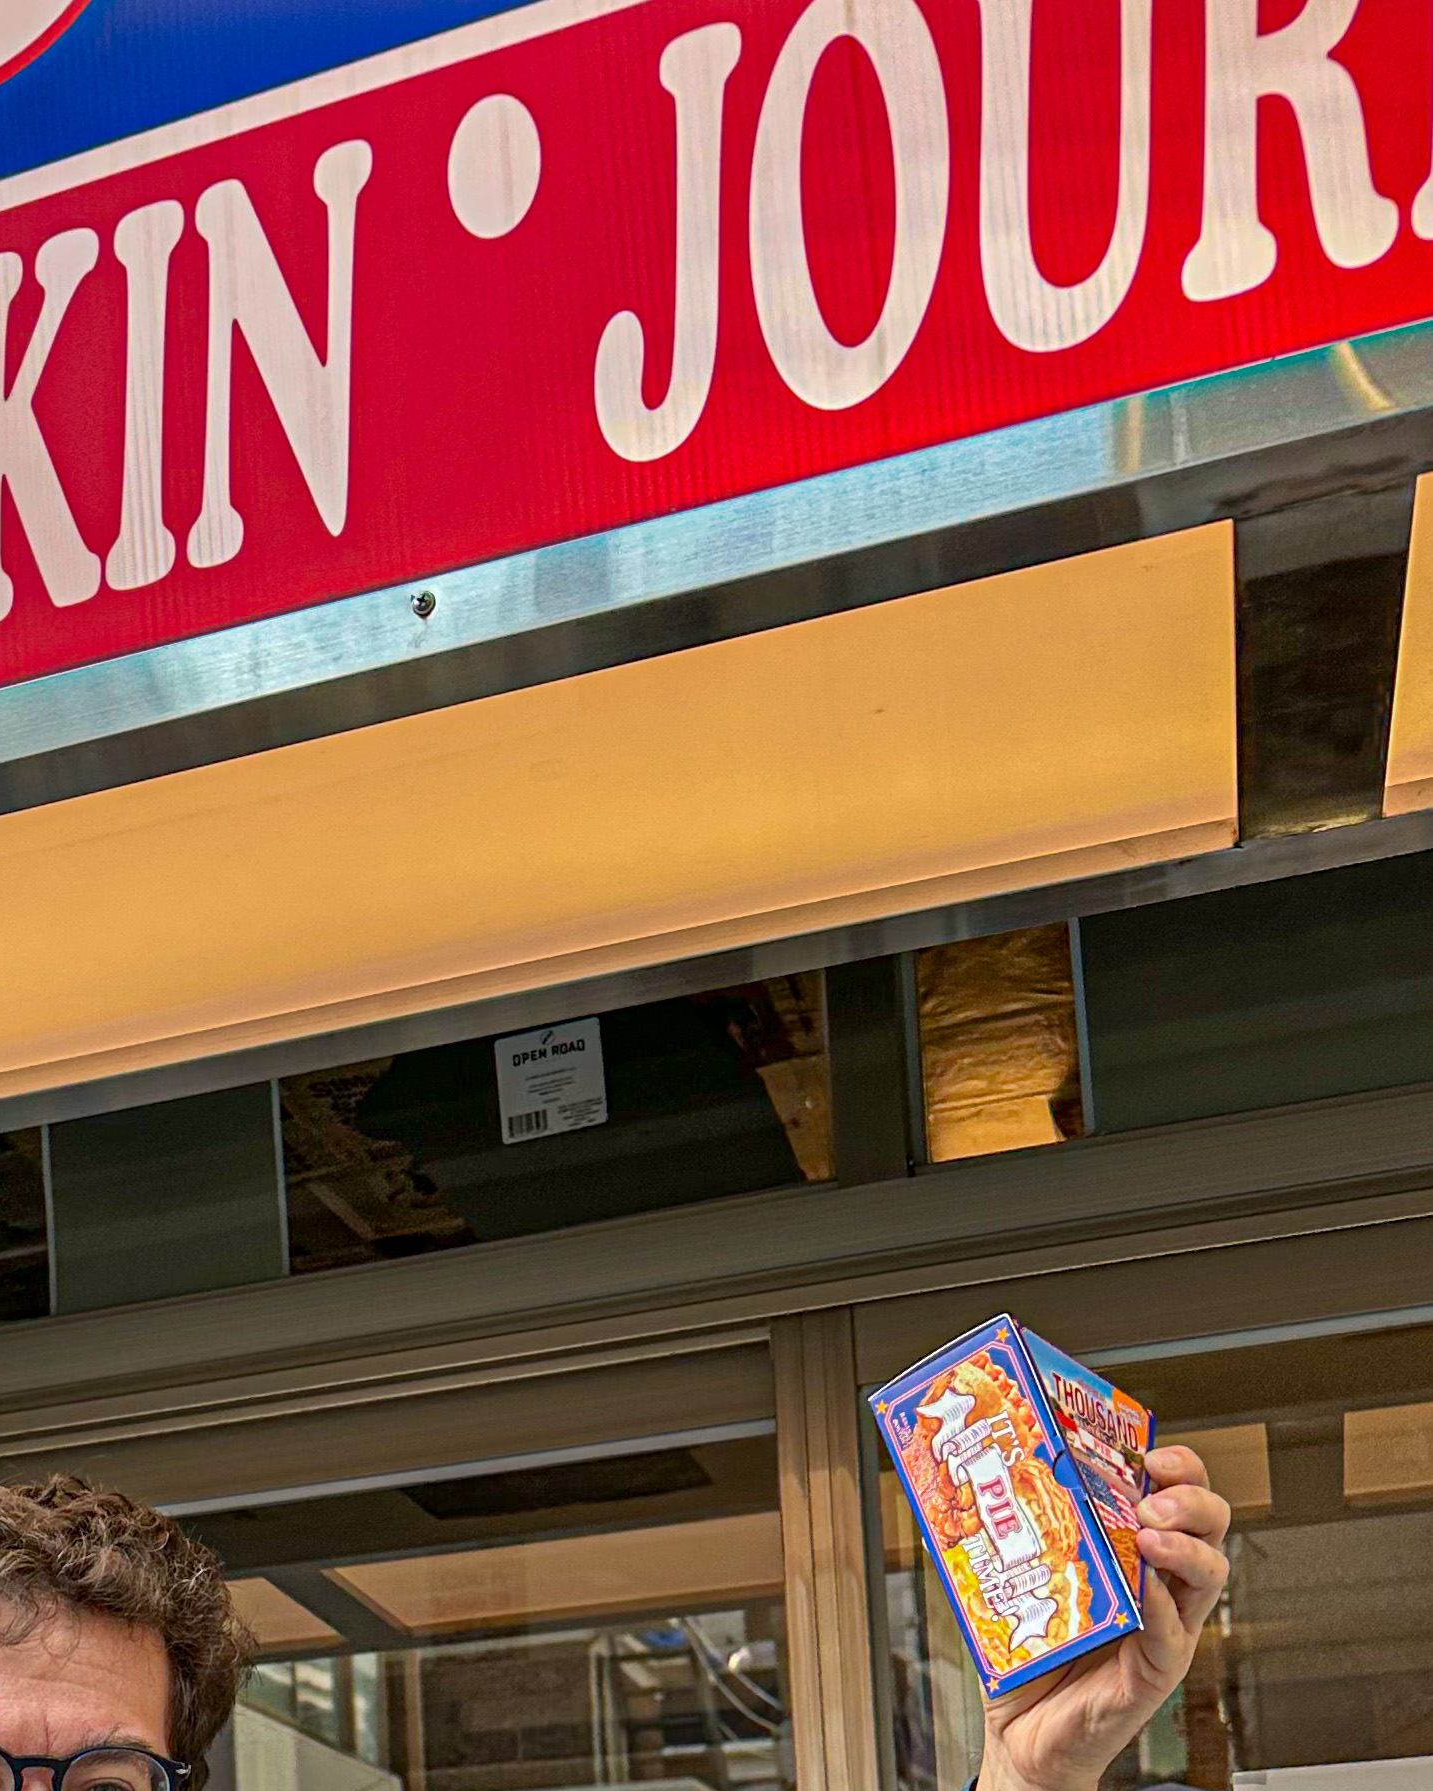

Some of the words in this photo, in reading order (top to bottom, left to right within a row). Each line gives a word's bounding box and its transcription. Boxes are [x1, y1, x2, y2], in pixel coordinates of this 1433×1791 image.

[594, 0, 1433, 462] JOUR
[513, 1048, 547, 1067] OPEN
[552, 1039, 585, 1056] ROAD
[987, 1411, 1026, 1467] IT'S
[1053, 1375, 1139, 1452] THOUSAND
[978, 1475, 1022, 1541] PIE
